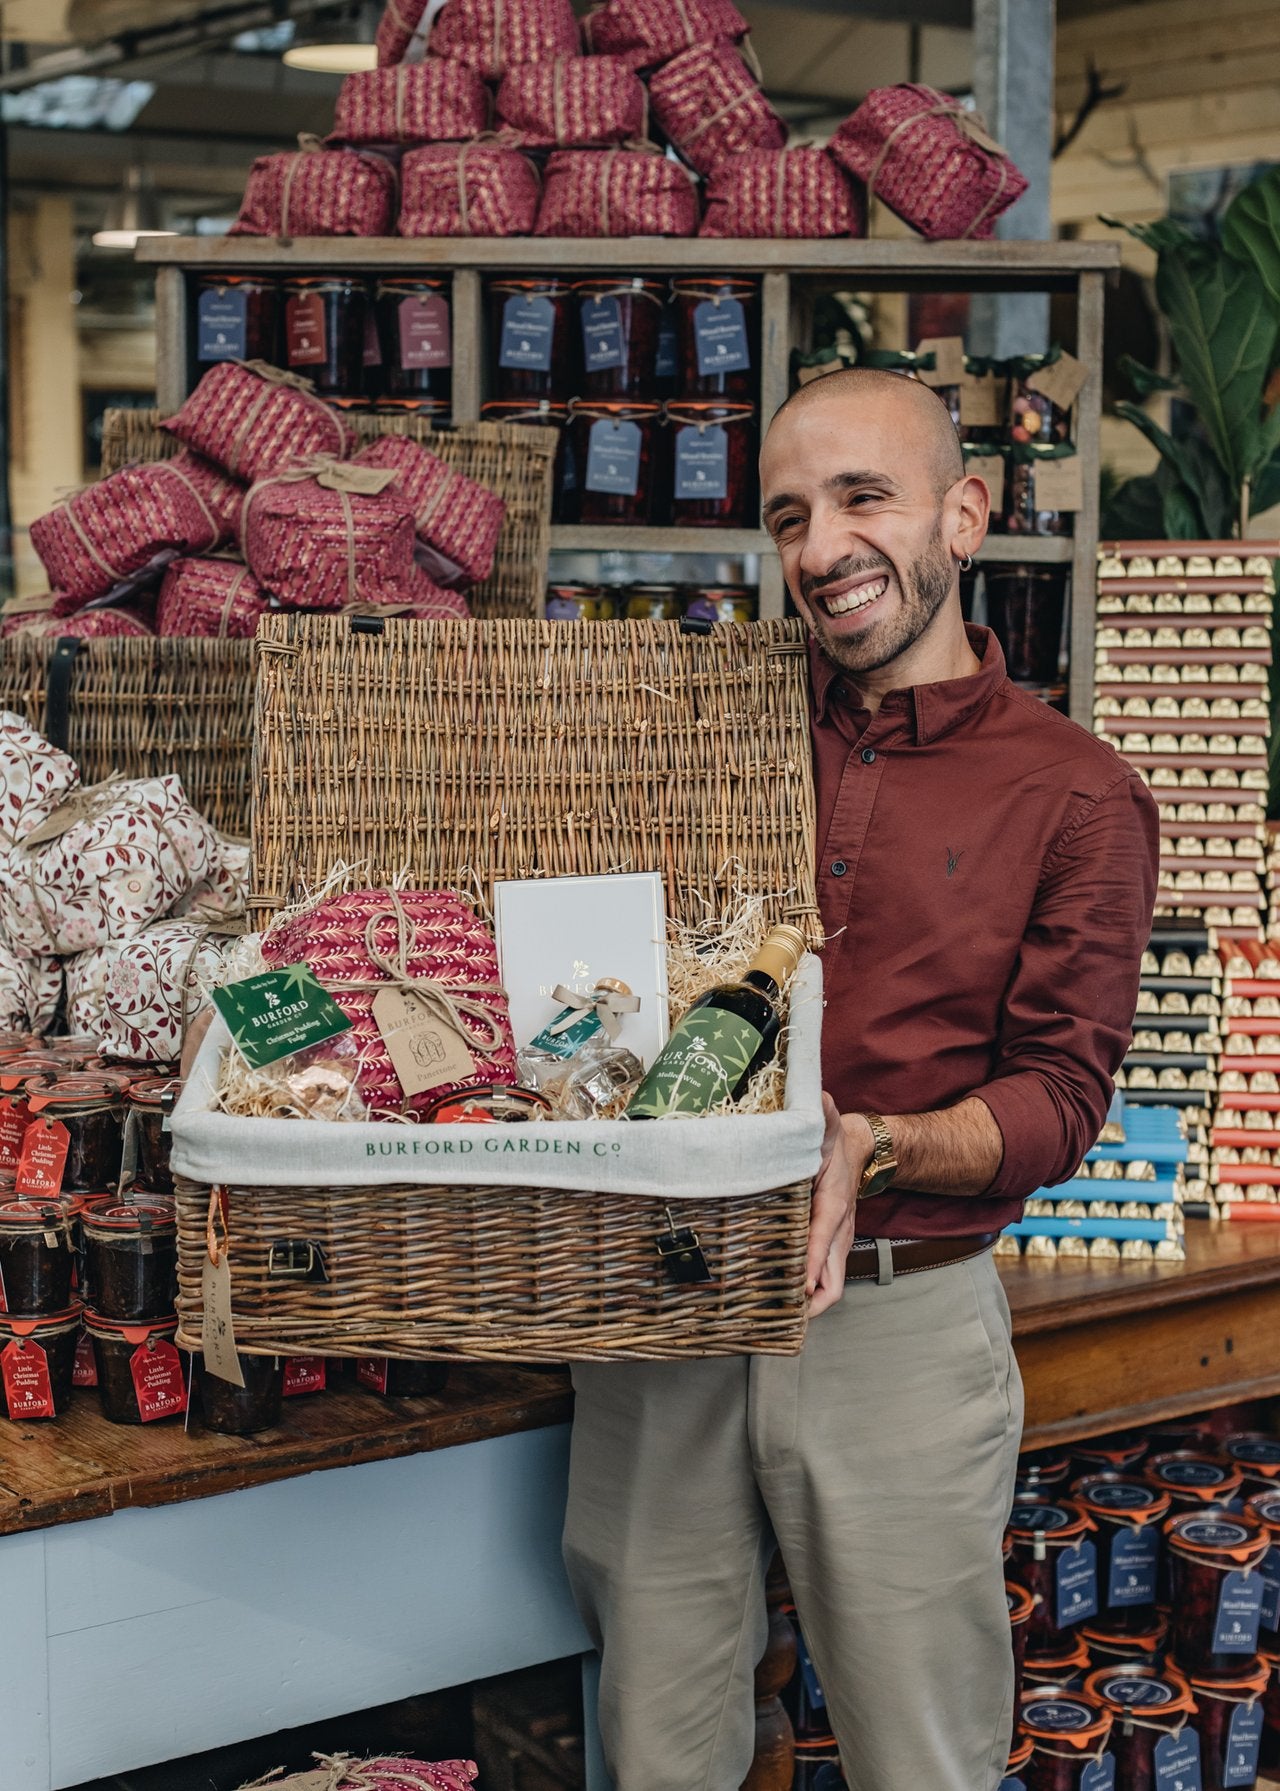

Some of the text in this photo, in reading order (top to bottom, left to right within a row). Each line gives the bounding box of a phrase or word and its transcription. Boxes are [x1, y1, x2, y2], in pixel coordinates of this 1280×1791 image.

[251, 1000, 309, 1027] BURFORD
[266, 1020, 320, 1045] Christmas Pudding
[287, 1033, 307, 1044] Fudge
[683, 1075, 701, 1088] Wine
[3, 1122, 18, 1130] Little
[366, 1139, 473, 1156] BURFORD
[484, 1138, 581, 1154] GARDEN
[31, 1150, 56, 1159] Christmas
[32, 1157, 54, 1167] Pudding
[22, 1178, 56, 1187] BURFORD
[149, 1366, 164, 1374] Little
[144, 1371, 172, 1382] Christmas
[286, 1374, 321, 1386] BURFORD
[147, 1378, 171, 1388] Pudding
[13, 1400, 48, 1408] BURFORD
[145, 1396, 182, 1411] BURFORD
